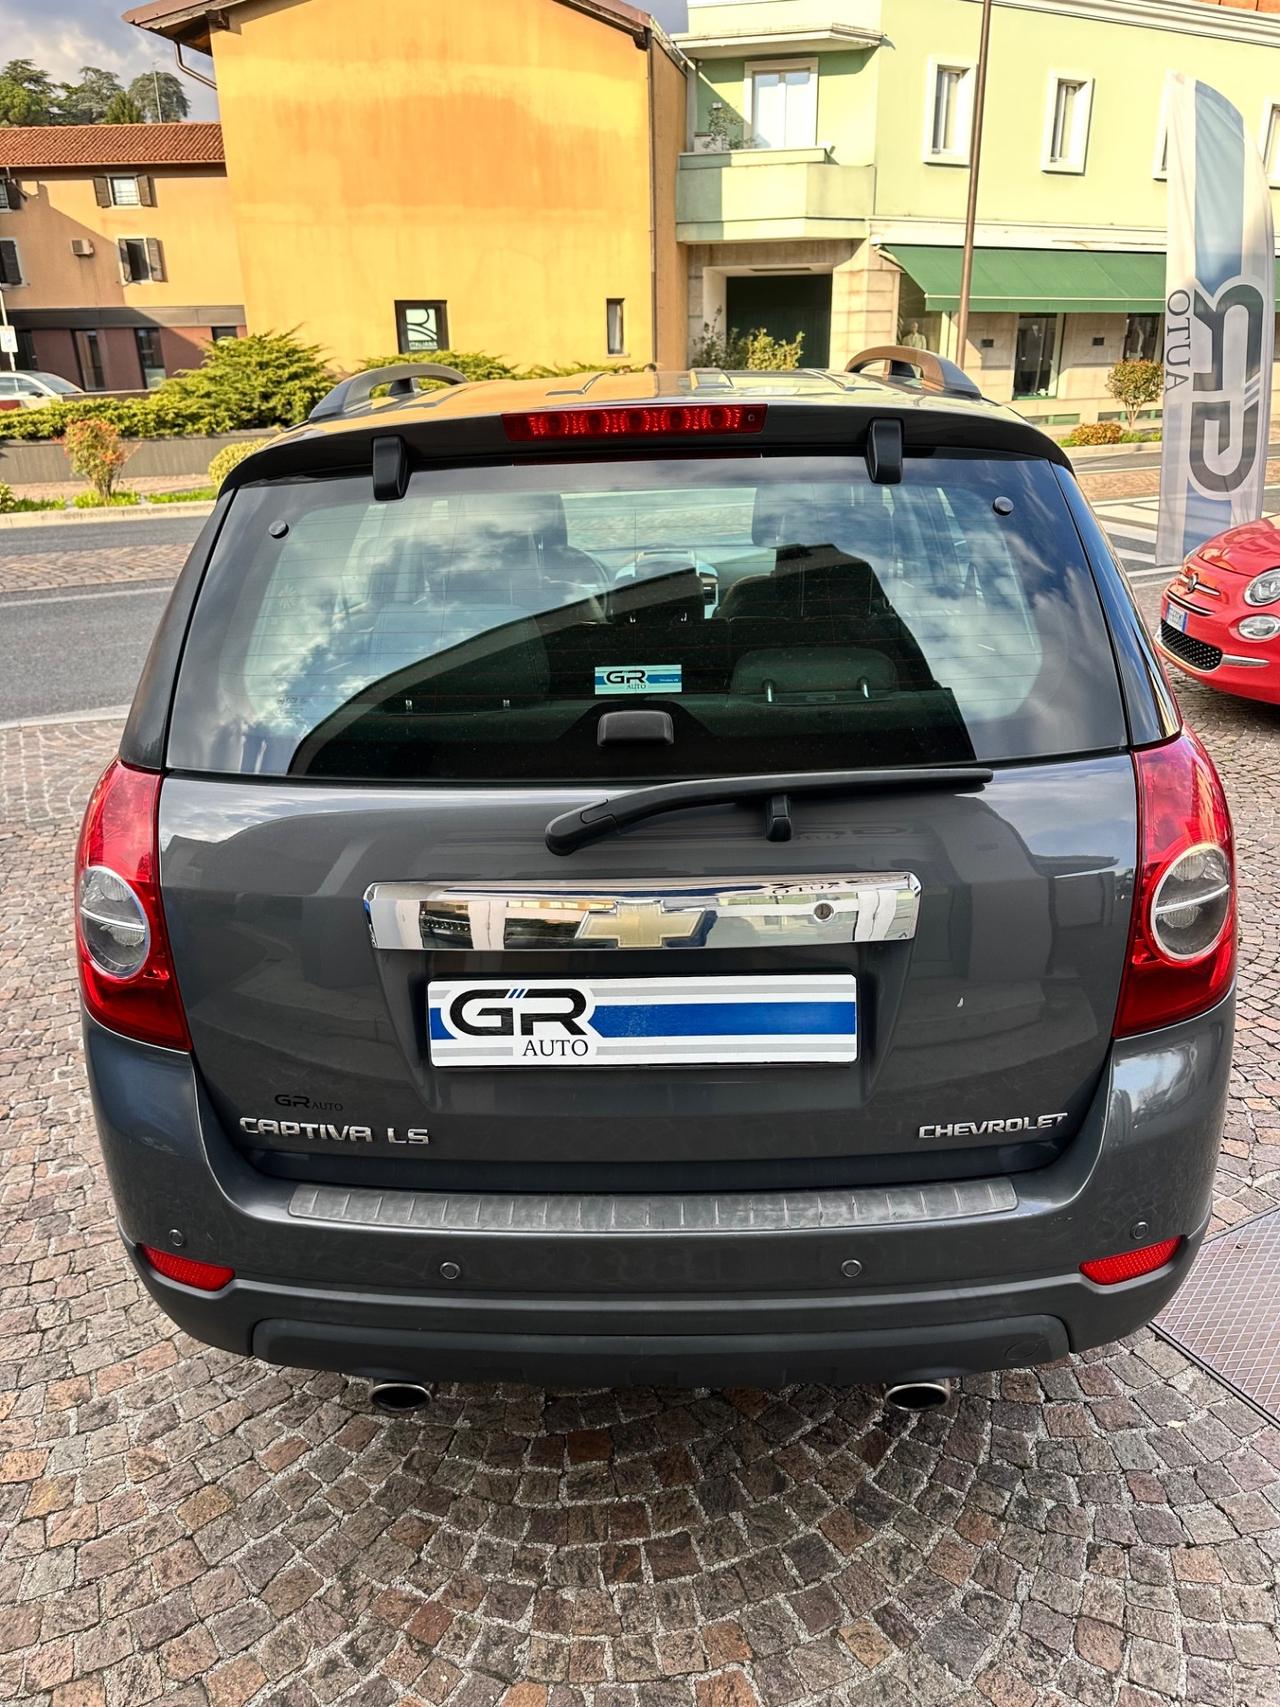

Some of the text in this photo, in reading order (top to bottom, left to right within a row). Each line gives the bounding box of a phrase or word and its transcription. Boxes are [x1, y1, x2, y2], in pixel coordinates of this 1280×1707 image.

[606, 670, 646, 684] GR
[450, 988, 588, 1037] GR
[522, 1039, 589, 1057] AUTO
[274, 1094, 344, 1112] GR AUTO
[239, 1117, 430, 1145] CAPTIVA LS
[919, 1112, 1068, 1139] CHEVROLET
